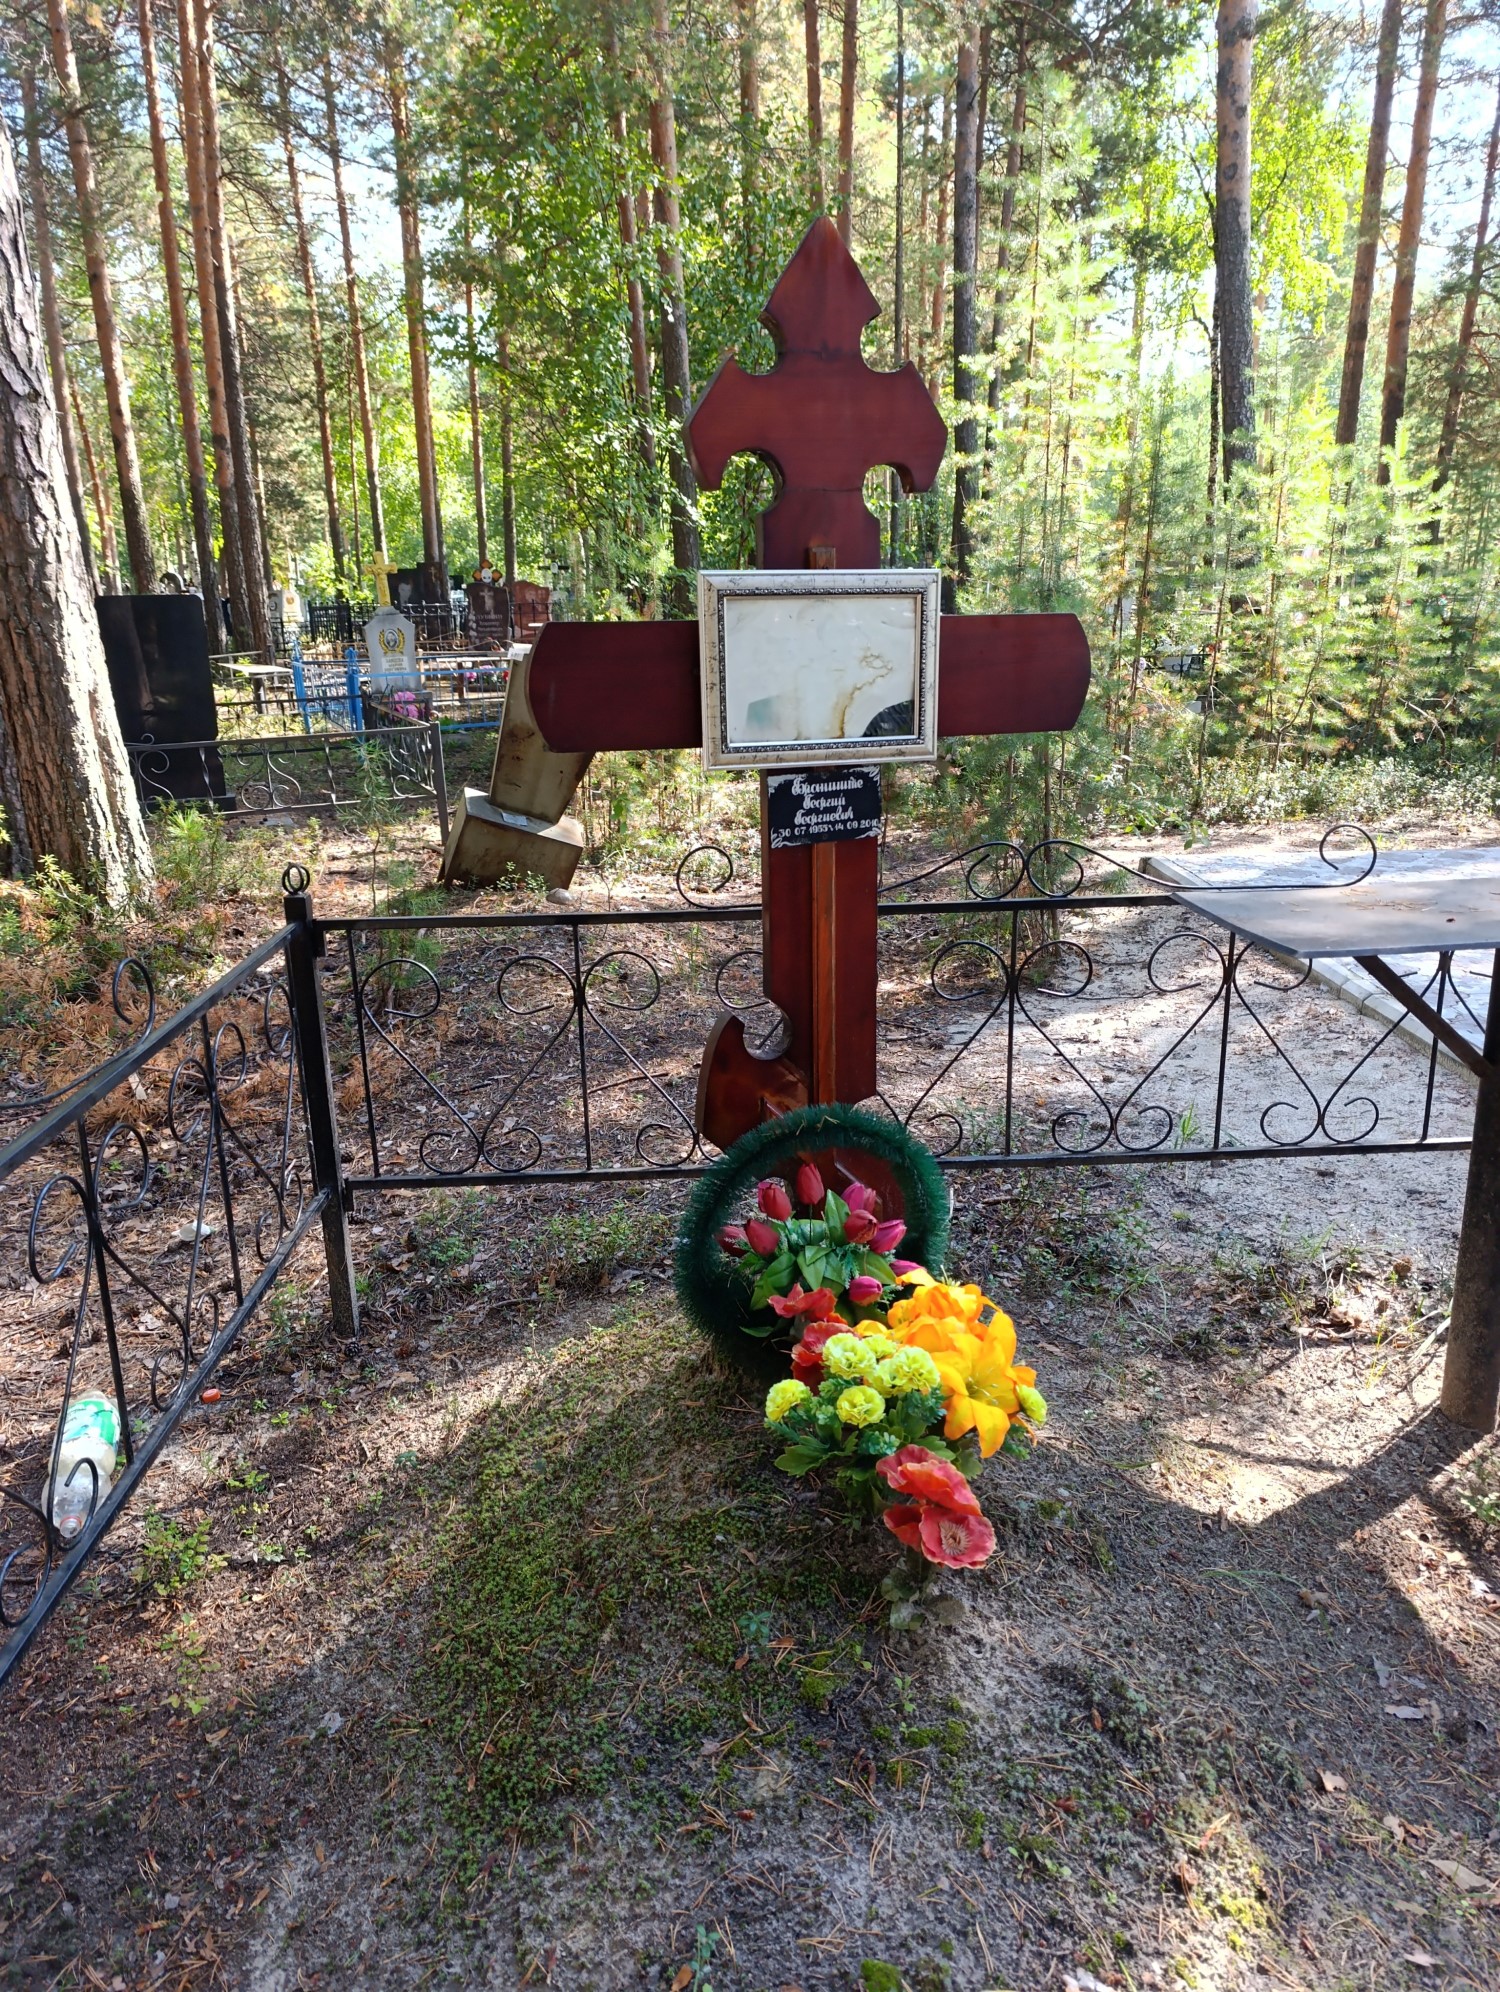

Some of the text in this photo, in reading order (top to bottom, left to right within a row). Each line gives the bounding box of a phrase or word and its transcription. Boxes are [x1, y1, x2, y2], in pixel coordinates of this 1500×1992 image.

[803, 793, 846, 810] Георгий
[794, 806, 854, 825] Георгиевич
[778, 828, 791, 838] 30
[794, 826, 807, 835] 07
